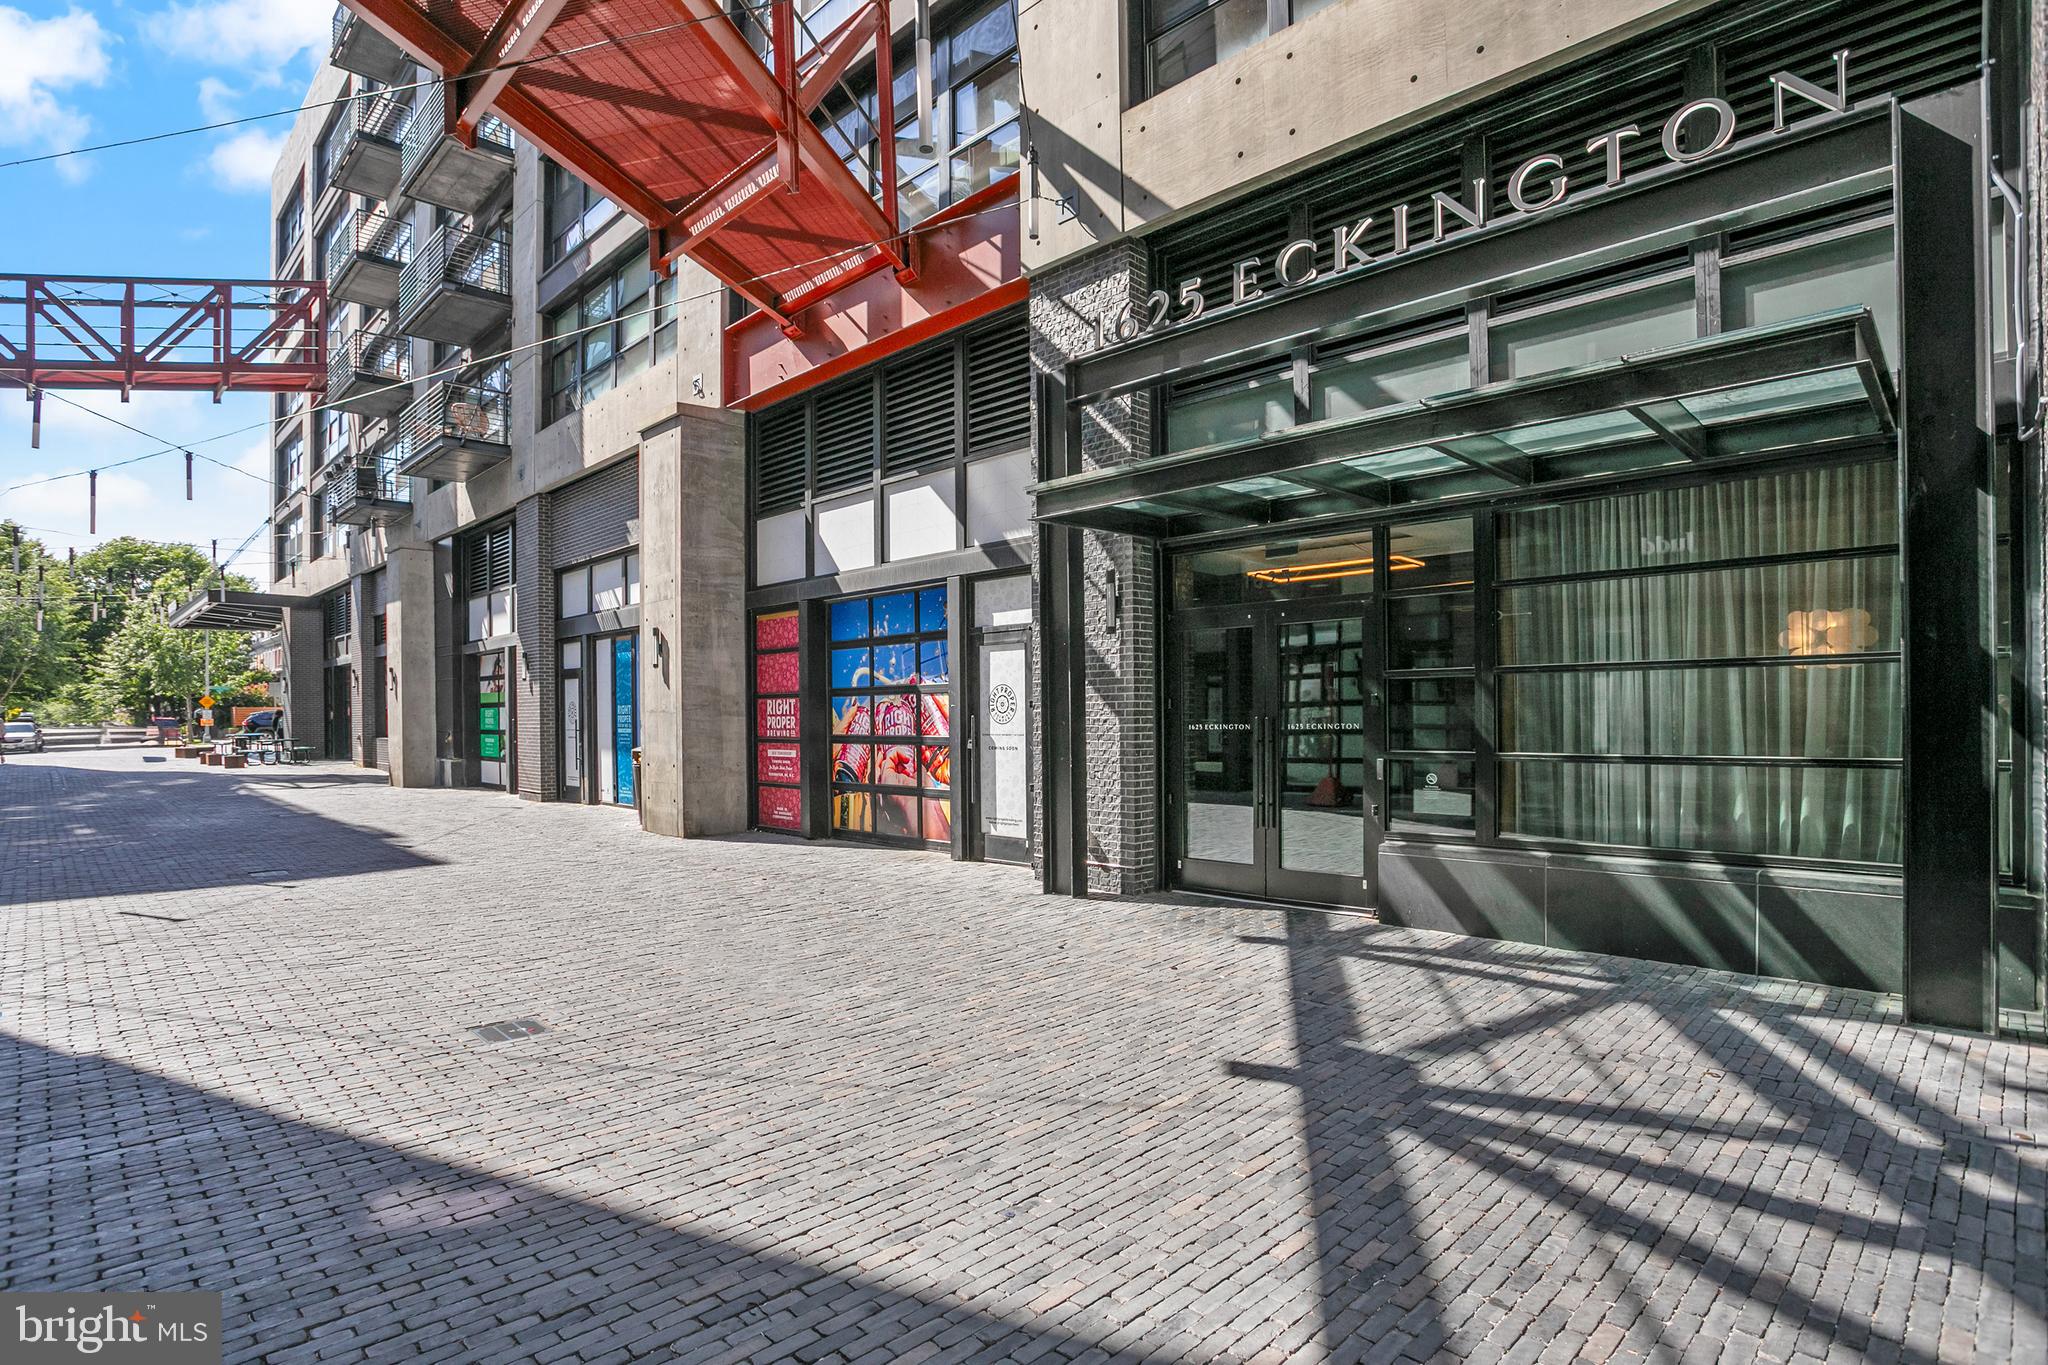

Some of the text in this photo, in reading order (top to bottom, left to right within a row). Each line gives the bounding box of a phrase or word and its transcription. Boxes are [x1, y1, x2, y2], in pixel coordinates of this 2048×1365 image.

[1094, 48, 1851, 351] 1625 ECKINGTON
[767, 699, 796, 715] RIGHT
[767, 716, 796, 729] PROPER
[1205, 723, 1251, 731] ECKINGTON
[1306, 722, 1360, 730] ECKINGTON
